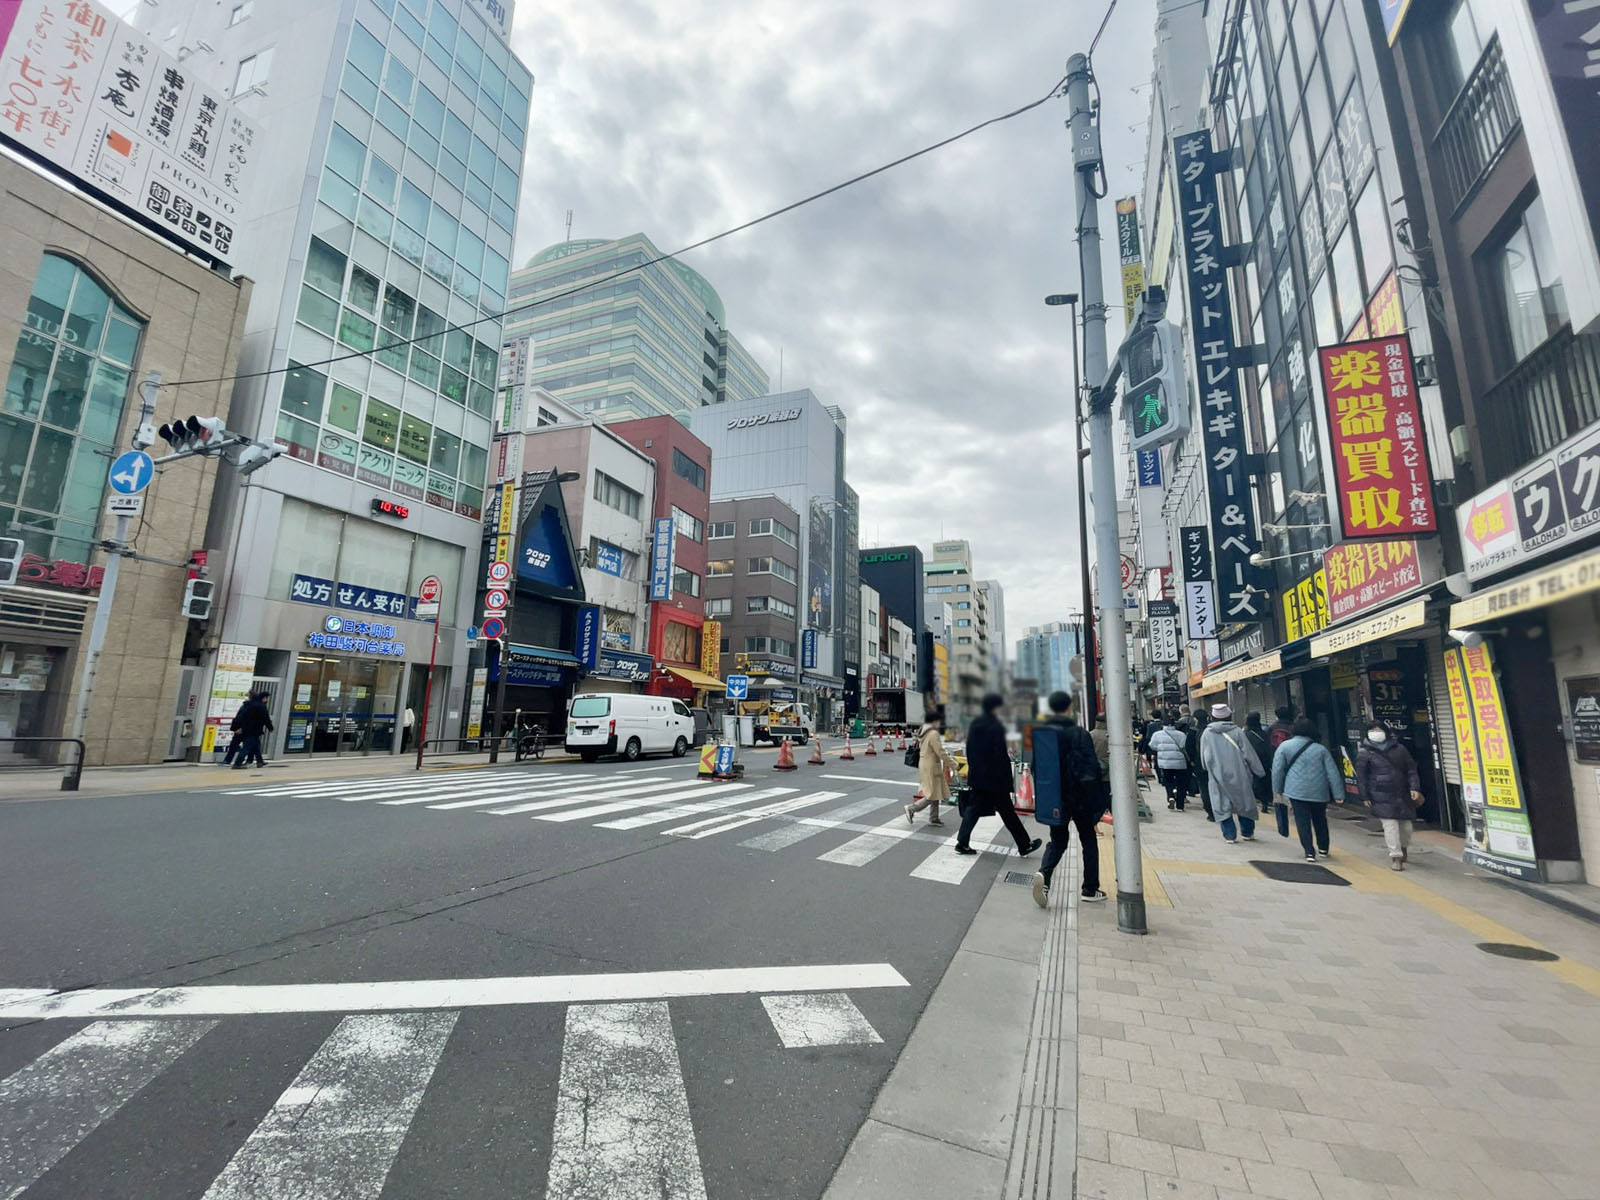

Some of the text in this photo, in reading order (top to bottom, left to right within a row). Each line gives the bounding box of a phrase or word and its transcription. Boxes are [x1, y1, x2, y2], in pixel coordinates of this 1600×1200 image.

[151, 67, 185, 138] 串焼酒場
[189, 93, 219, 159] 東京丸鶏
[159, 160, 235, 215] PRONTO
[149, 180, 233, 243] 御茶ノ水
[1329, 350, 1404, 528] 楽器買取
[1384, 343, 1429, 526] 現金買取・高額スピード査定
[526, 548, 551, 563] クロサワ
[863, 551, 909, 564] union
[1188, 531, 1204, 578] ギブソン
[1531, 529, 1558, 547] ALOHA
[493, 567, 506, 577] 40
[1328, 540, 1413, 596] 楽器買取
[292, 579, 405, 615] 処方せん受付
[308, 633, 405, 657] 神田駿河台薬局
[342, 617, 397, 640] 日本調剤
[1151, 619, 1162, 660] クラシック
[1163, 619, 1175, 660] ウクレレ
[617, 660, 639, 671] クロサワ
[630, 670, 650, 680] ウインド
[1446, 652, 1475, 769] 中古エレキ
[1465, 648, 1505, 760] 買取受付
